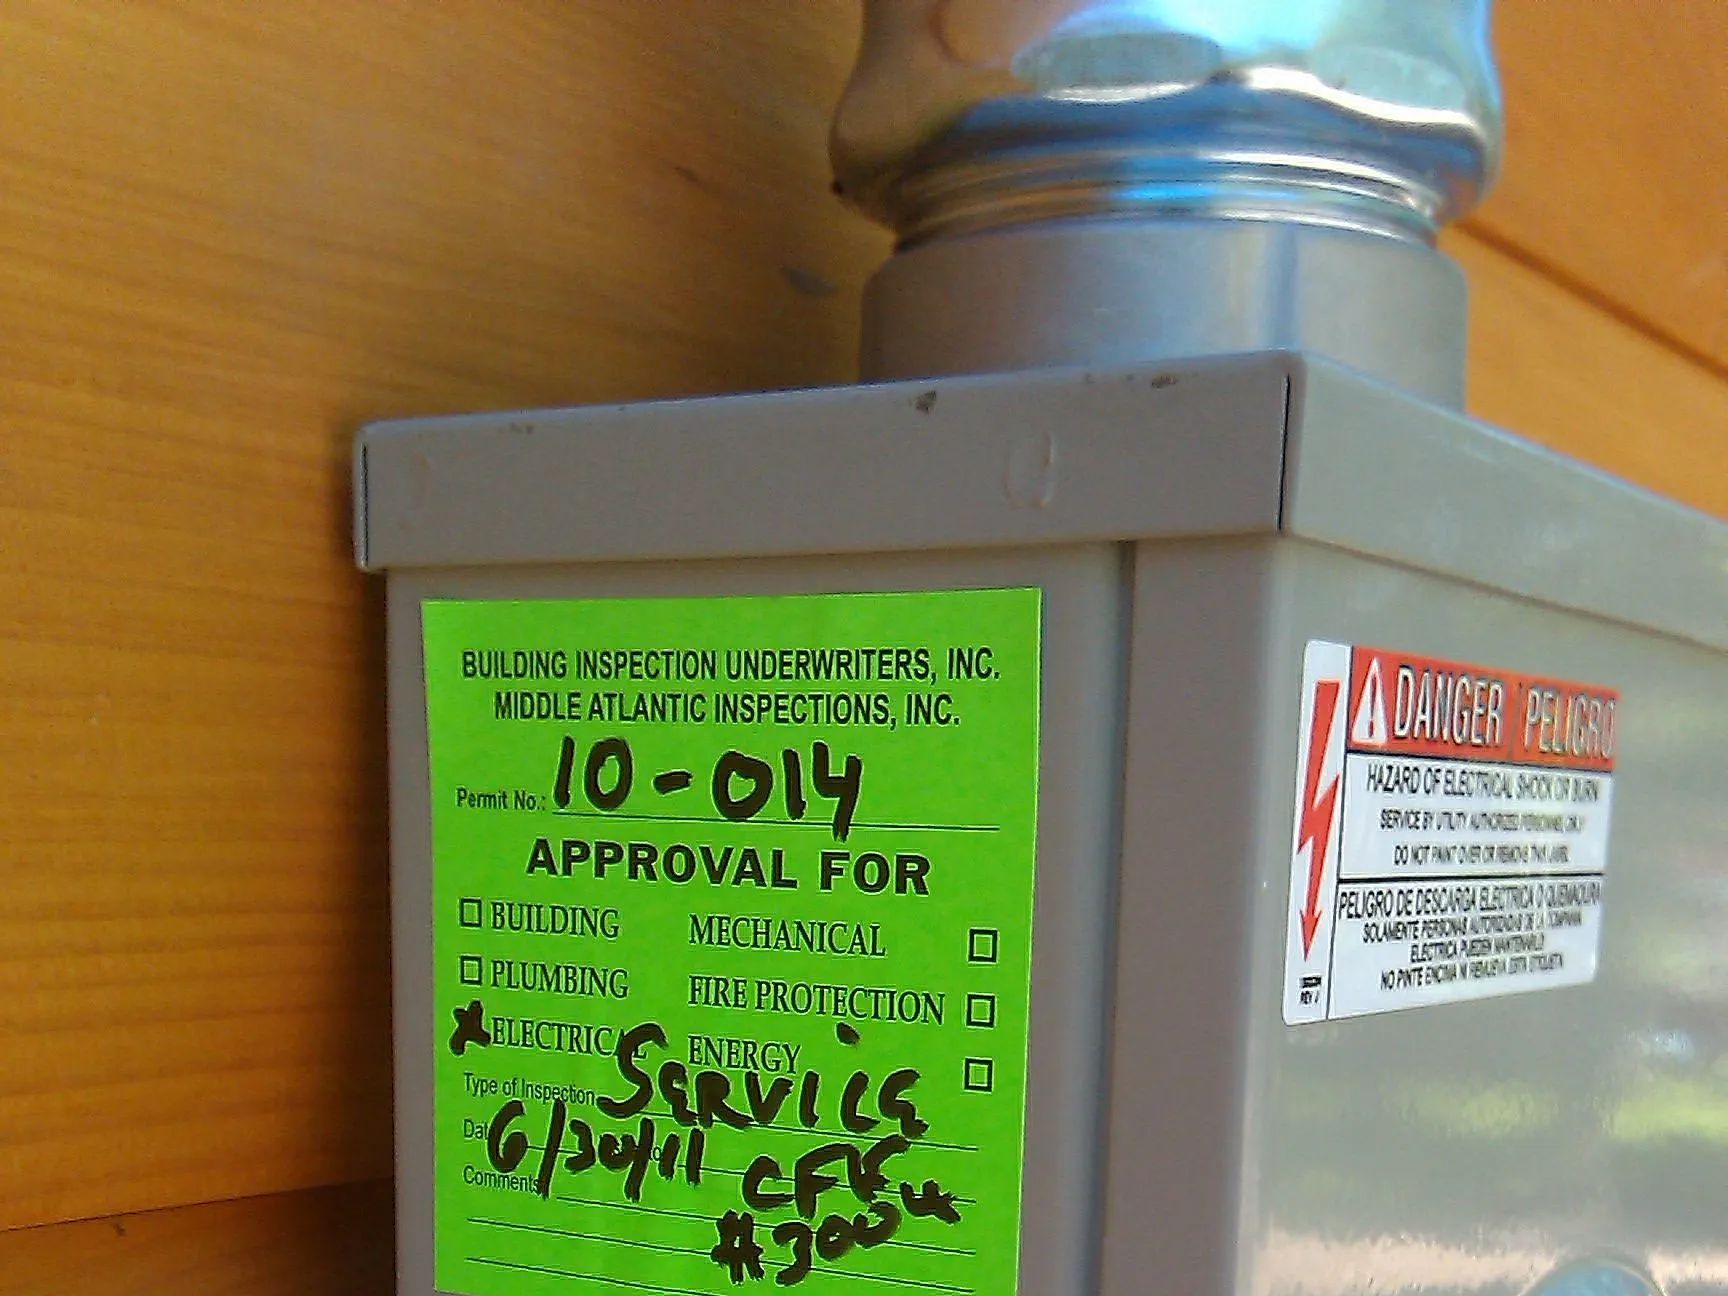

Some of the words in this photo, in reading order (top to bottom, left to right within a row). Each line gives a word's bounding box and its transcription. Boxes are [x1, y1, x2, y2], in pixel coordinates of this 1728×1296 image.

[462, 650, 568, 680] BUILDING
[576, 650, 716, 680] INSPECTION
[725, 649, 938, 686] UNDERWRITERS,
[947, 647, 1001, 680] INC.
[494, 691, 582, 721] MIDDLE
[587, 692, 706, 723] ATLANTIC
[714, 693, 897, 731] INSPECTIONS,
[905, 694, 961, 726] INC.
[1393, 664, 1503, 747] DANGER
[1524, 685, 1615, 760] PELIGRO
[1367, 763, 1420, 795] HAZARD
[1423, 767, 1441, 795] OF
[455, 787, 508, 810] Permit
[513, 790, 546, 812] No.:
[1380, 808, 1420, 830] SERVICE
[525, 837, 798, 890] APPROVAL
[820, 850, 931, 896] FOR
[1394, 845, 1409, 866] DO
[490, 901, 620, 939] BUILDING
[1338, 889, 1393, 919] PELIGRO
[1398, 889, 1415, 916] DE
[1416, 886, 1475, 915] DESCARGA
[688, 914, 887, 958] MECHANICAL
[1363, 920, 1419, 943] SOLAMENTE
[490, 959, 629, 999] PLUMBING
[1380, 970, 1395, 991] NO
[688, 975, 748, 1009] FIRE
[754, 979, 946, 1026] PROTECTION
[491, 1016, 648, 1061] ELECTRIC
[688, 1034, 801, 1074] ENERGY
[463, 1072, 498, 1098] Type
[502, 1077, 518, 1097] of
[521, 1078, 596, 1106] Inspection
[463, 1118, 498, 1142] Dat
